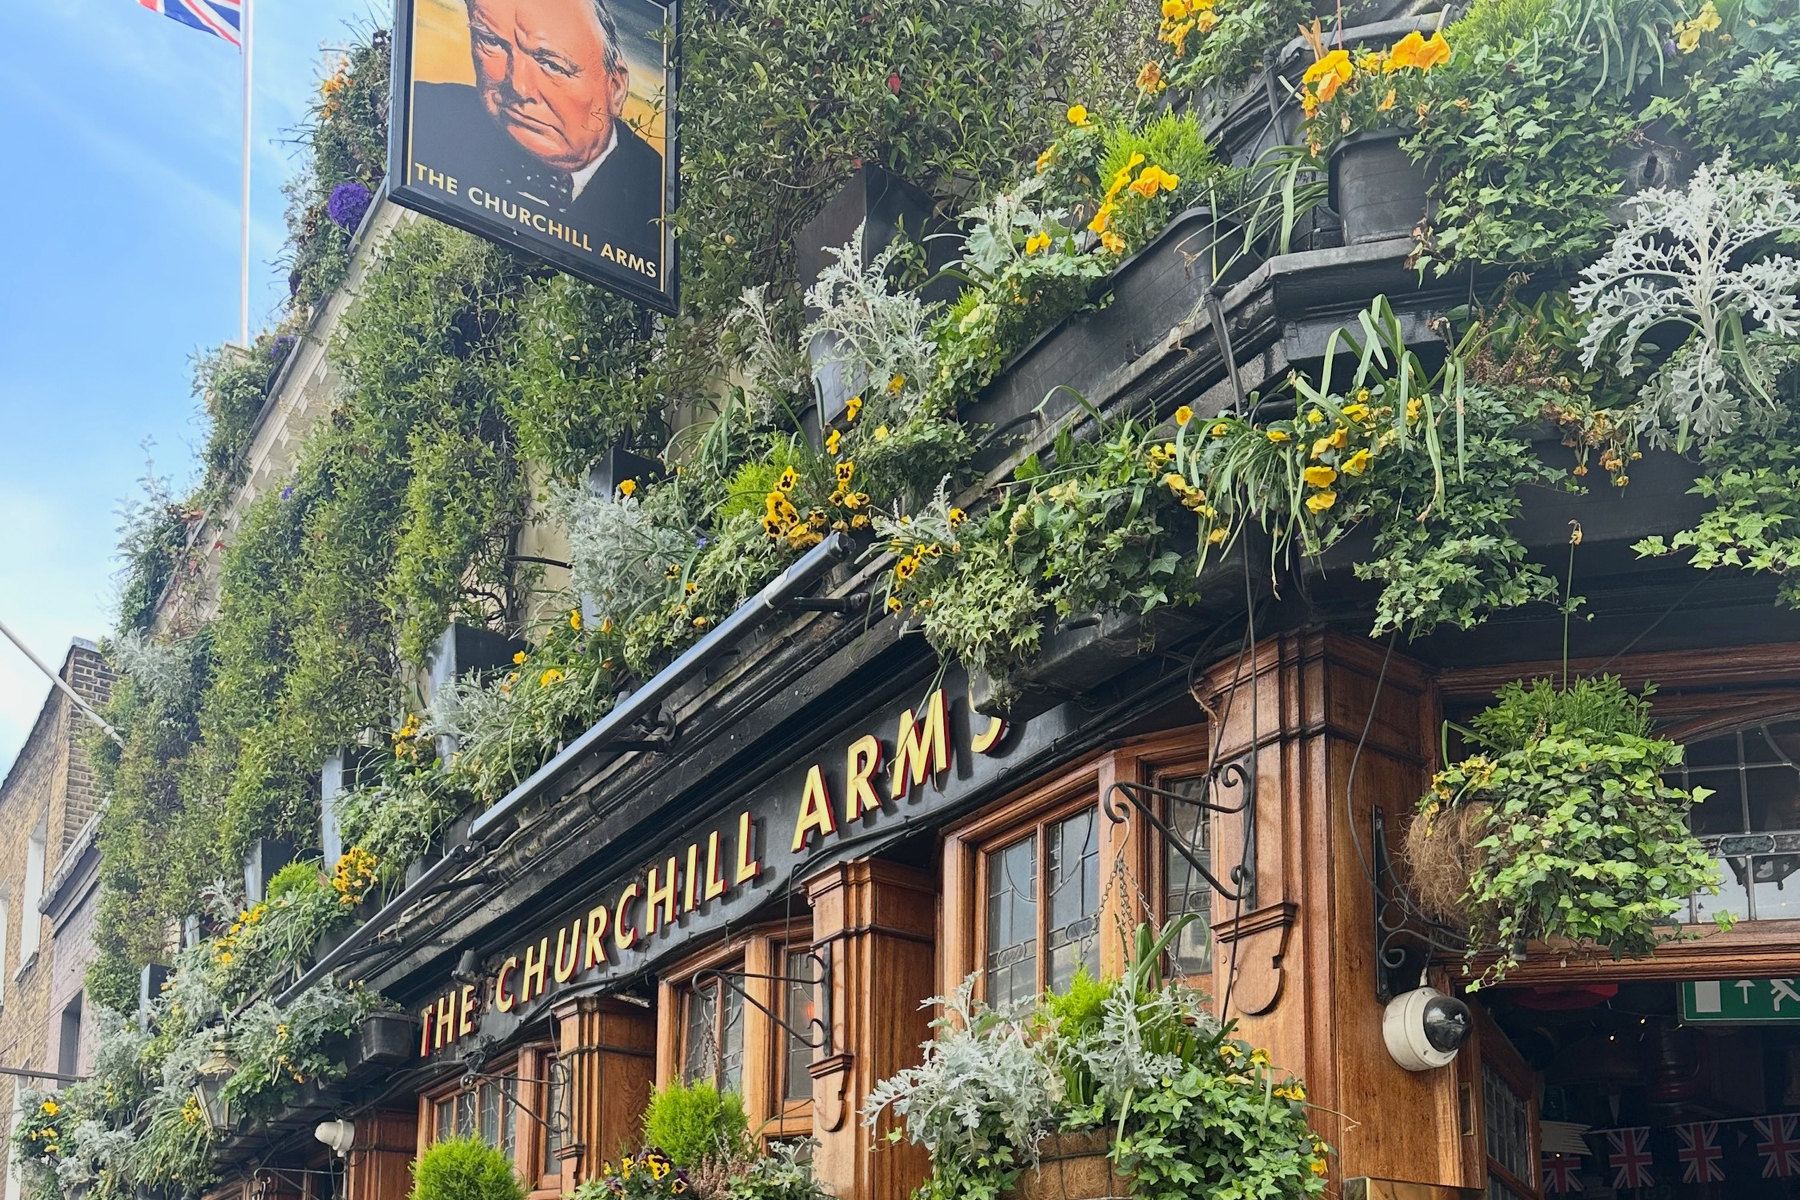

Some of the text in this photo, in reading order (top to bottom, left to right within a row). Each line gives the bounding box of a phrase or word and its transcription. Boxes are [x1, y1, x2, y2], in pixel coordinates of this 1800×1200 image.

[415, 163, 657, 279] THE CHURCHILL ARMS
[421, 984, 477, 1058] THE
[495, 811, 760, 1014] CHURCHILL
